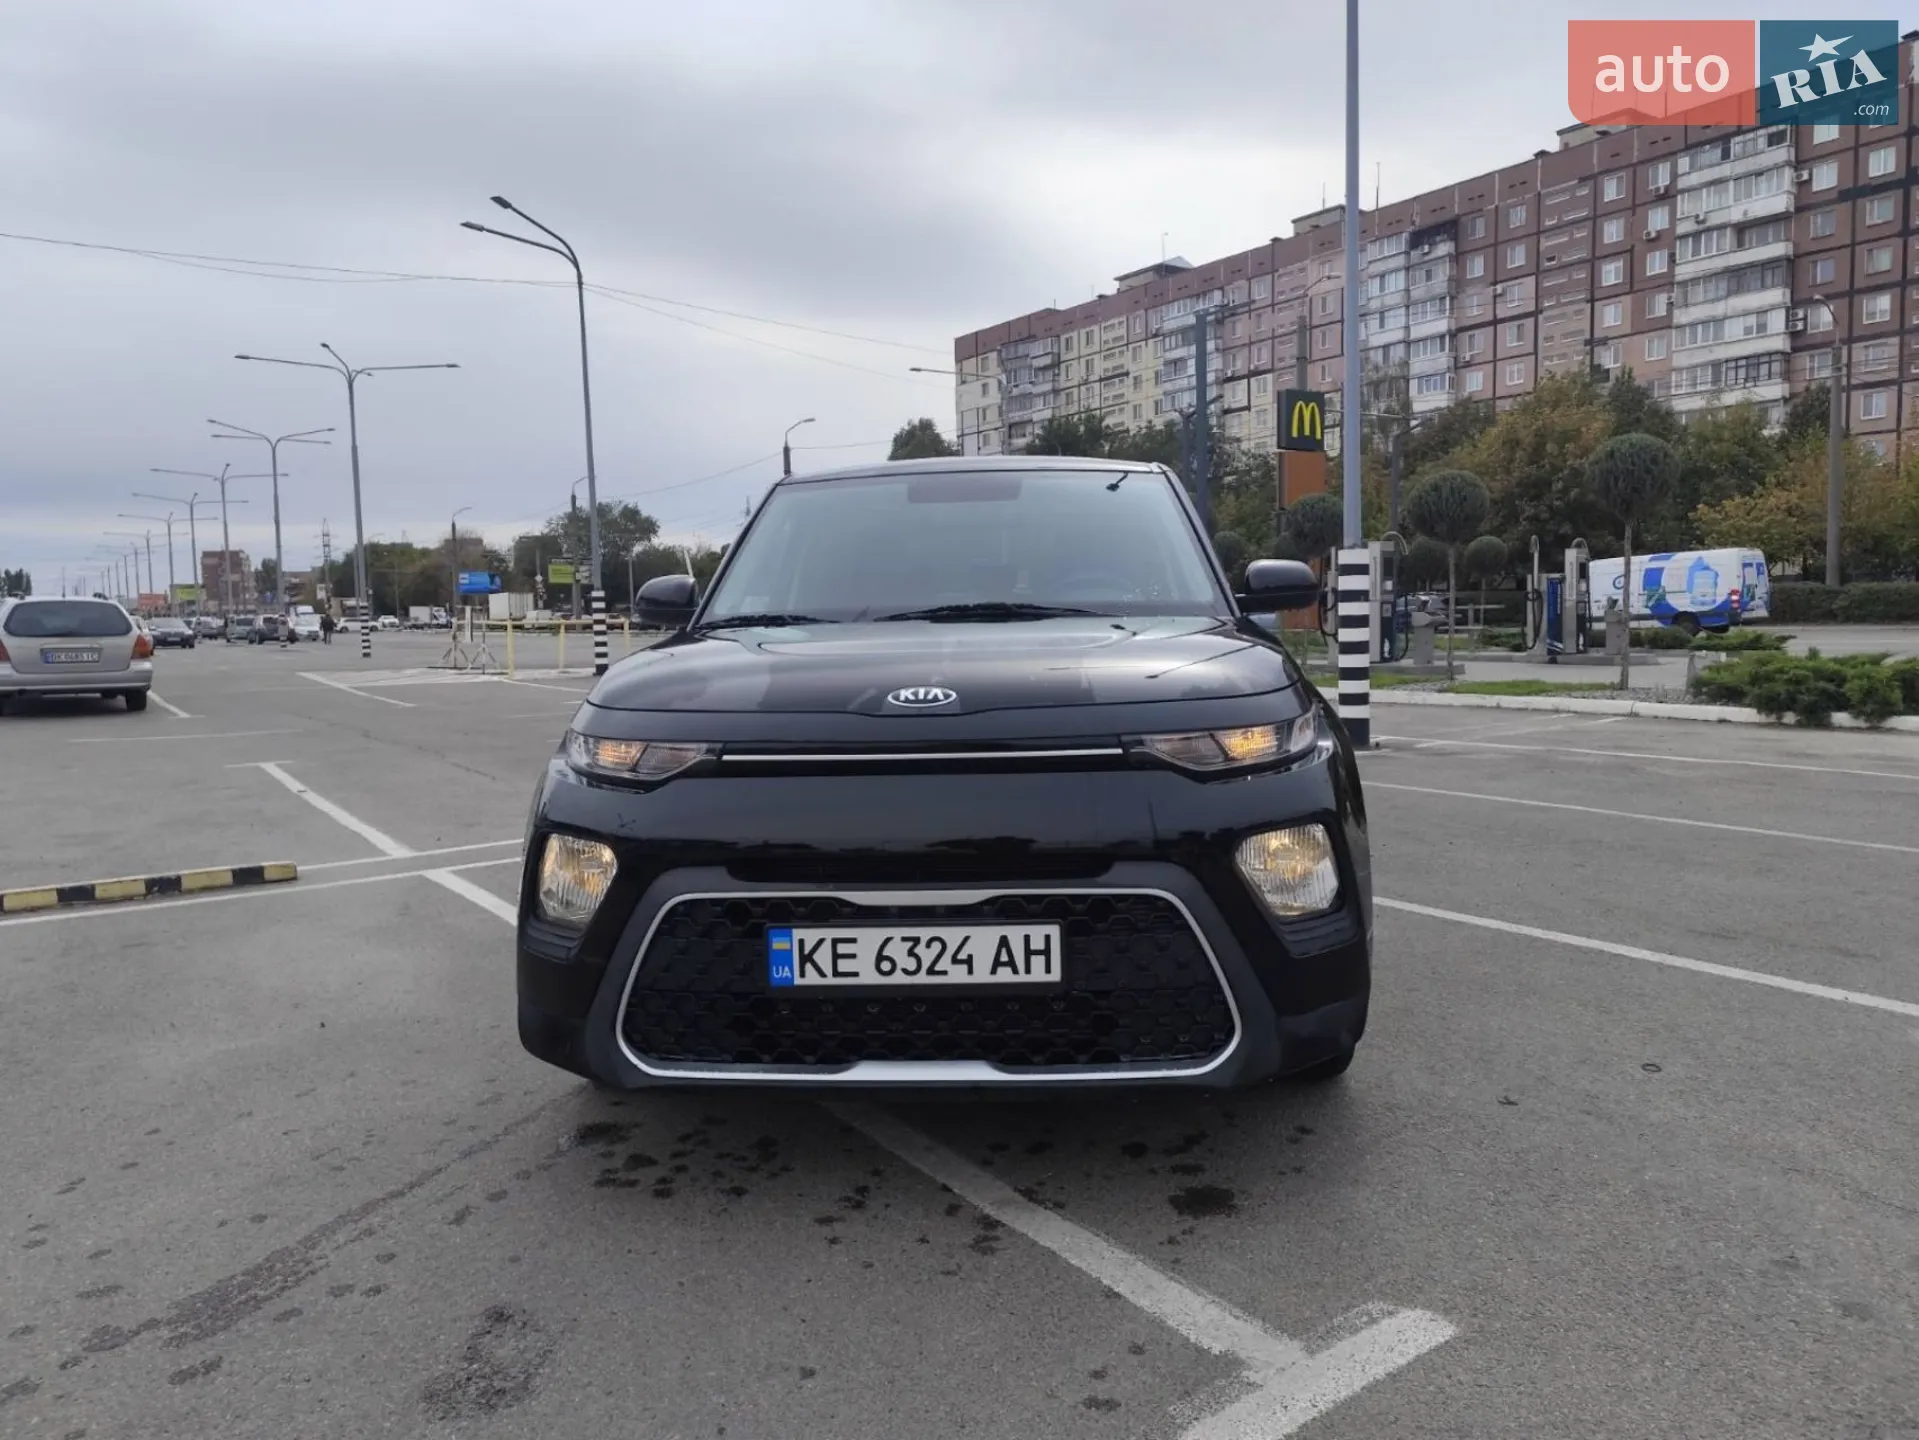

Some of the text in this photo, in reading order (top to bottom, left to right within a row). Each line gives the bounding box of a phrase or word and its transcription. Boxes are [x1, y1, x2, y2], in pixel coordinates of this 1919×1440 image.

[899, 688, 945, 701] KIA
[798, 934, 1052, 978] KE 6324 AH
[773, 966, 792, 979] UA
